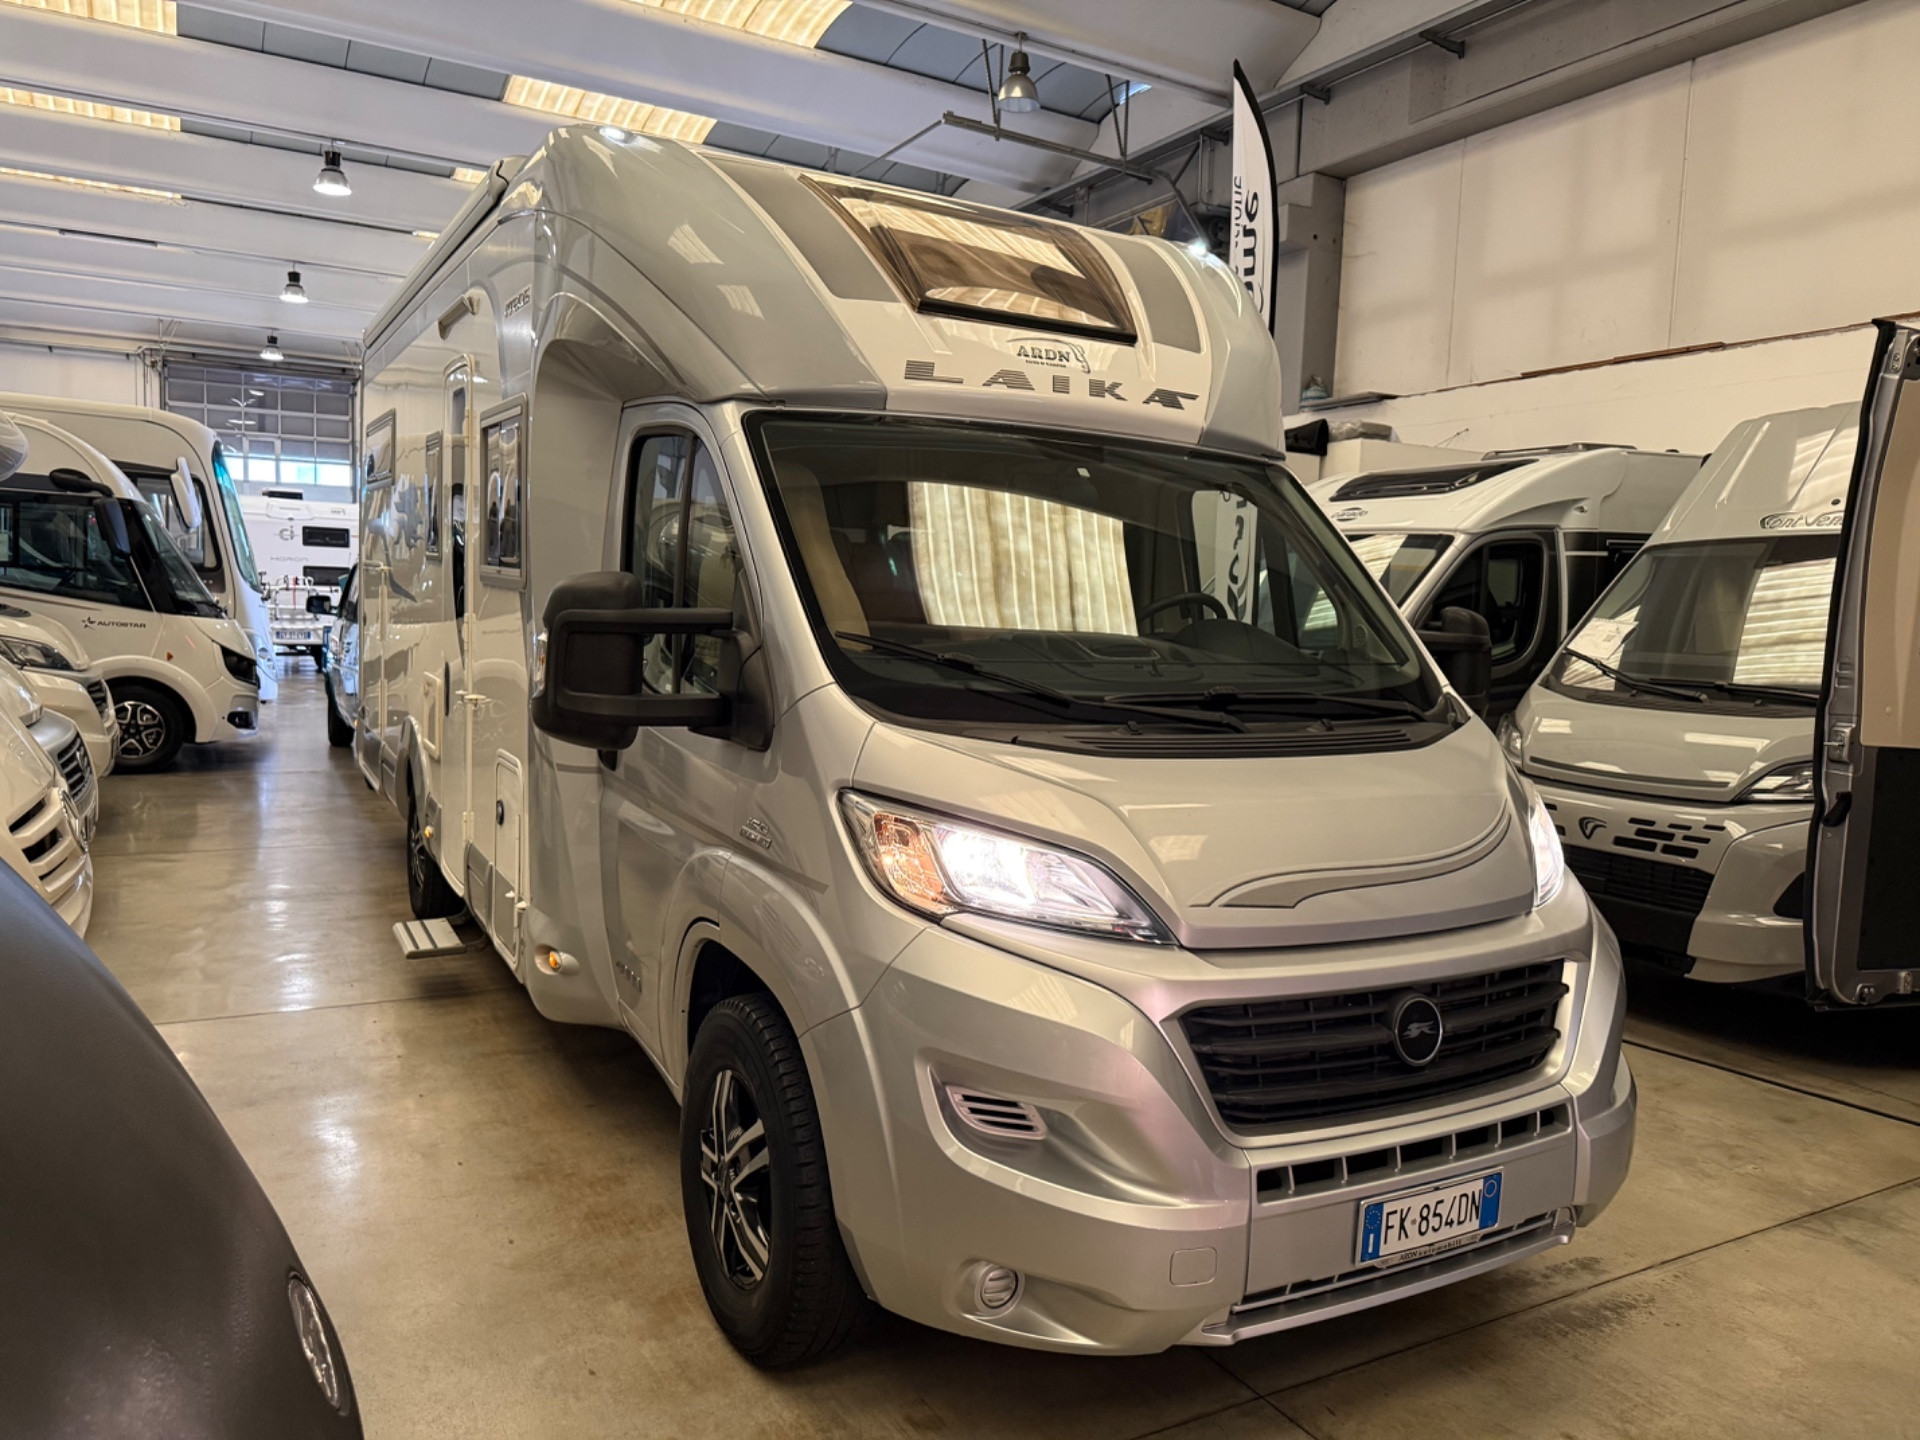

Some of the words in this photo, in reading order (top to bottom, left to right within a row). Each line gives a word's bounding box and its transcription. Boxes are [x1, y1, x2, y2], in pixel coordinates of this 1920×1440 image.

[1017, 345, 1071, 362] ARDN
[904, 359, 1200, 410] LAIKA
[97, 620, 146, 629] AUTOSTAR
